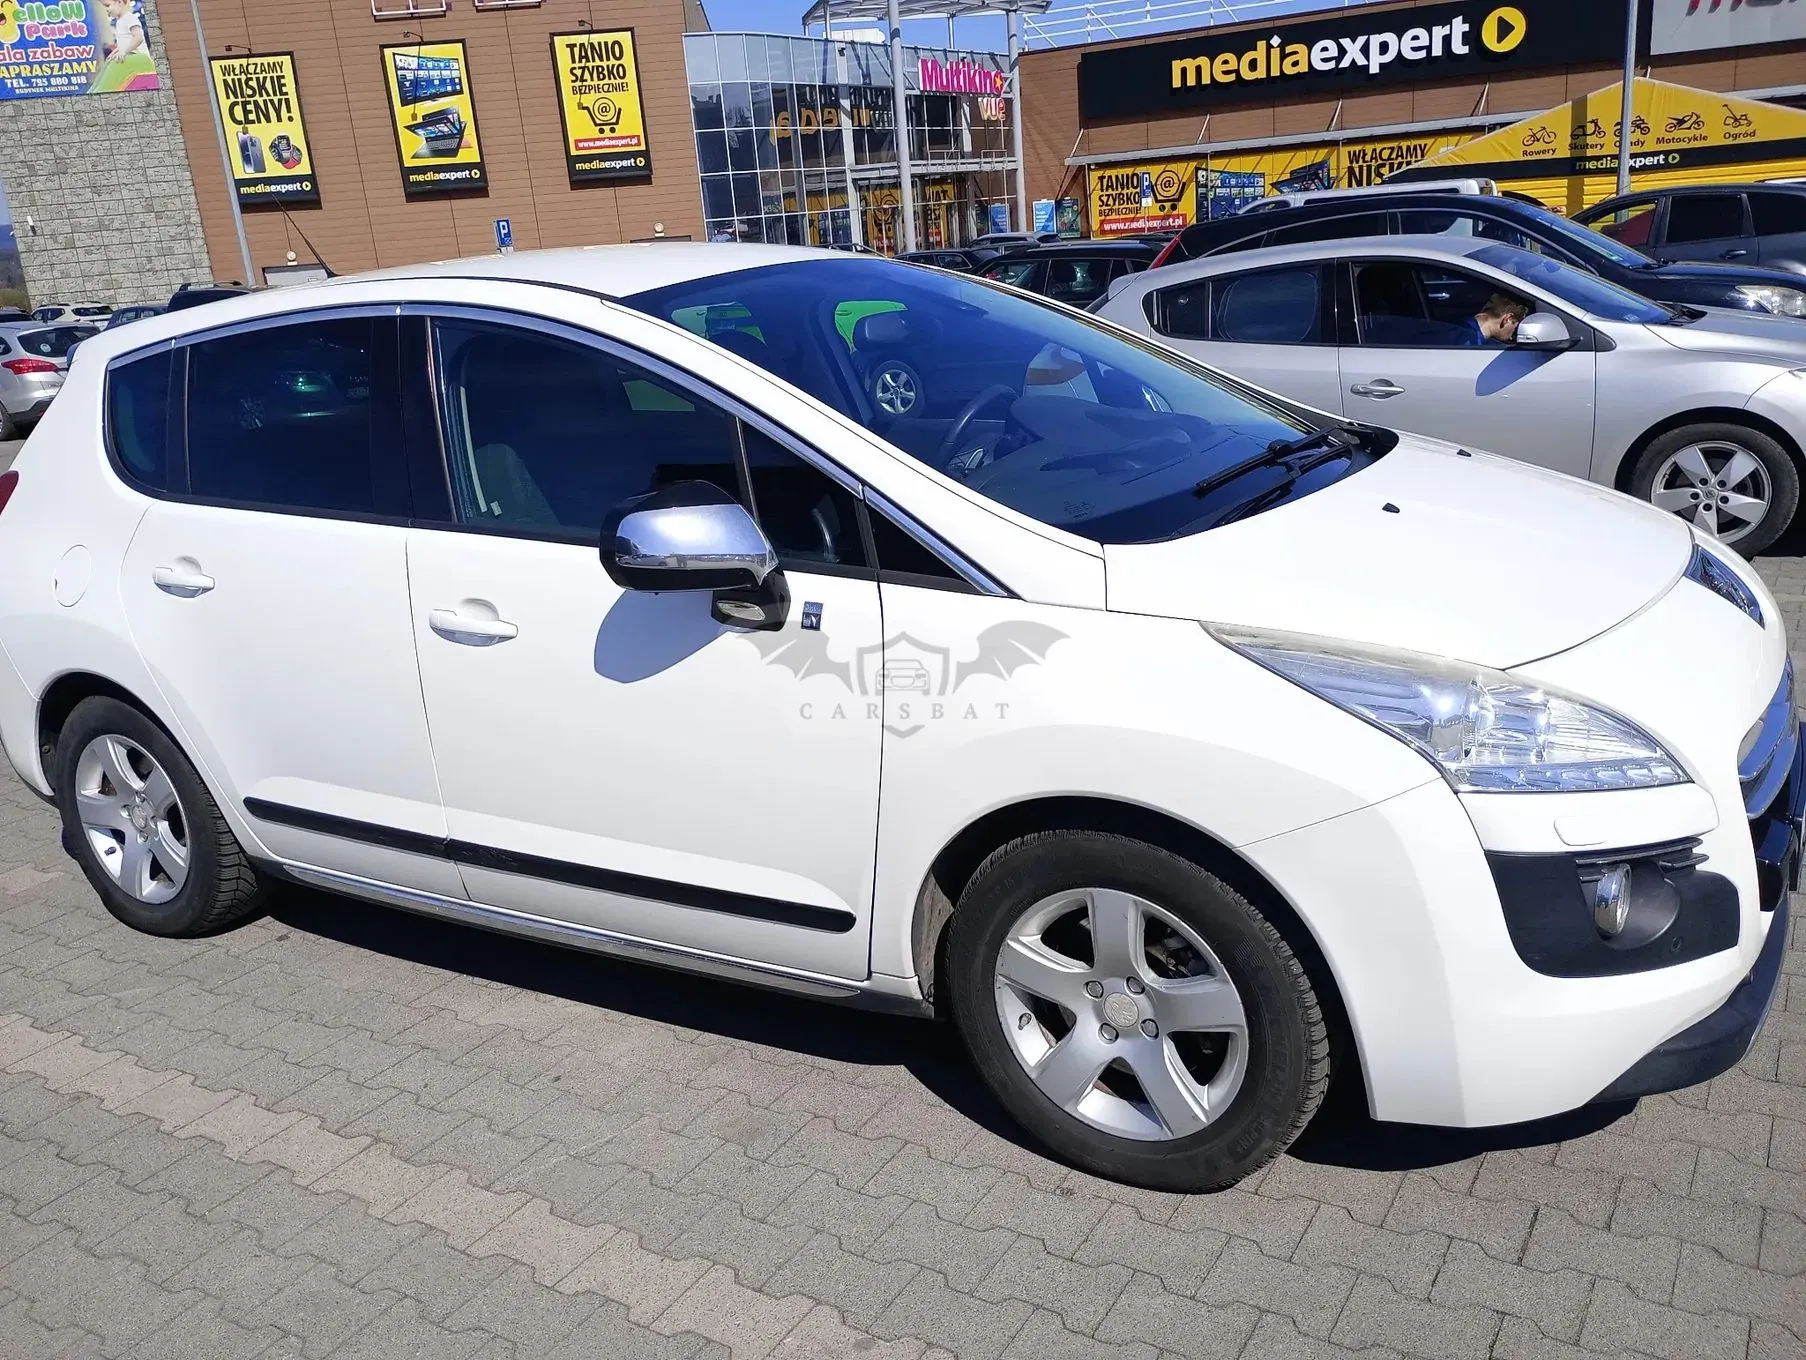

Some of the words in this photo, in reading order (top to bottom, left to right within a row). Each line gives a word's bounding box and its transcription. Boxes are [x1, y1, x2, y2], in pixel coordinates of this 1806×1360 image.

[28, 41, 94, 61] zabaw
[566, 40, 624, 64] TANIO
[1171, 15, 1470, 88] mediaexpert
[569, 63, 627, 83] SZYBKO
[918, 58, 1005, 95] Multikino
[5, 78, 29, 88] TEL.
[222, 75, 289, 100] NISKIE
[572, 82, 629, 95] BEZPIECZNIE!
[228, 98, 294, 125] CENY!
[1656, 134, 1708, 145] Motocykle
[1723, 129, 1757, 141] Ogród
[1522, 147, 1557, 157] Rowery
[1568, 142, 1604, 151] Skutery
[575, 157, 635, 170] mediaexpert
[1576, 154, 1665, 169] mediaxpert
[409, 169, 470, 182] mediaexpert
[1097, 172, 1140, 192] TANIO
[240, 181, 302, 195] mediaexpert
[1098, 191, 1140, 207] SZYBKO
[500, 221, 508, 238] P
